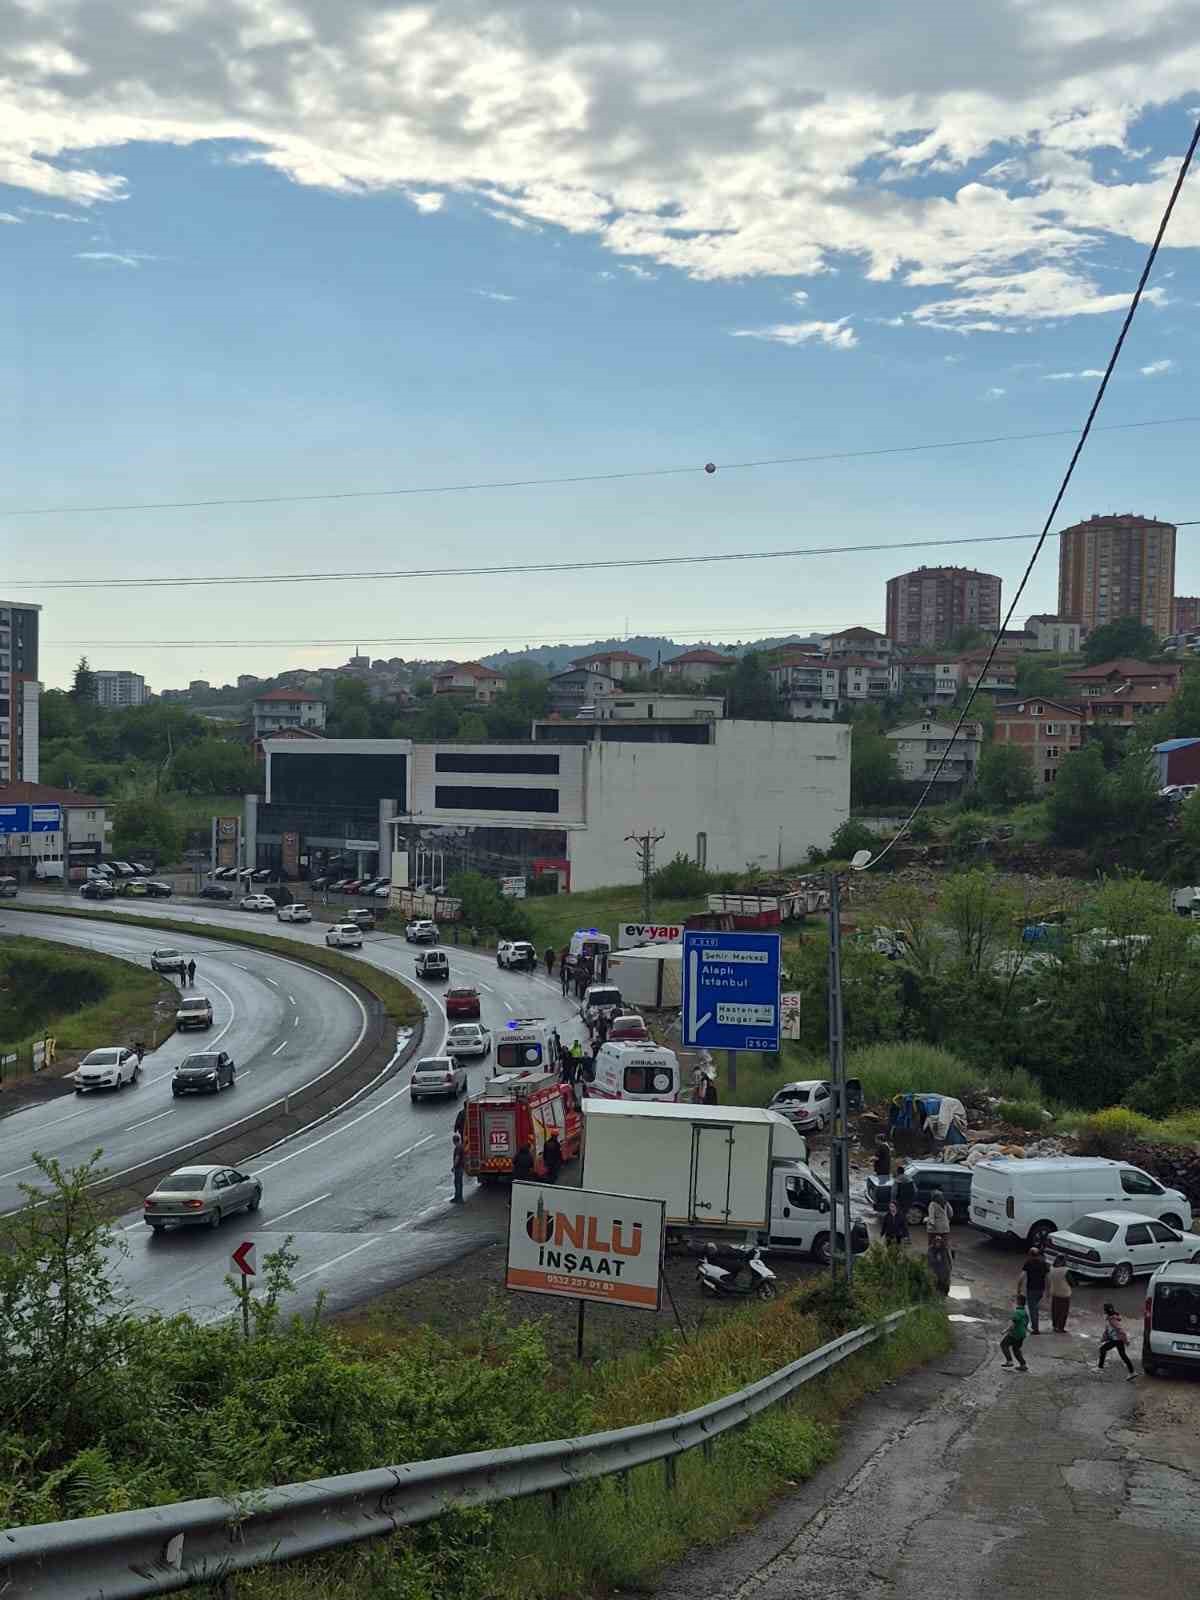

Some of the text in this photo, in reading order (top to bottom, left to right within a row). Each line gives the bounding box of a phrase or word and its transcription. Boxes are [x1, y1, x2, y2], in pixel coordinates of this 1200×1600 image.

[625, 924, 680, 941] ev-yap
[748, 1040, 768, 1048] 250
[491, 1132, 507, 1145] 112
[526, 1208, 643, 1257] ÜNLÜ
[538, 1246, 625, 1277] İNŞAAT
